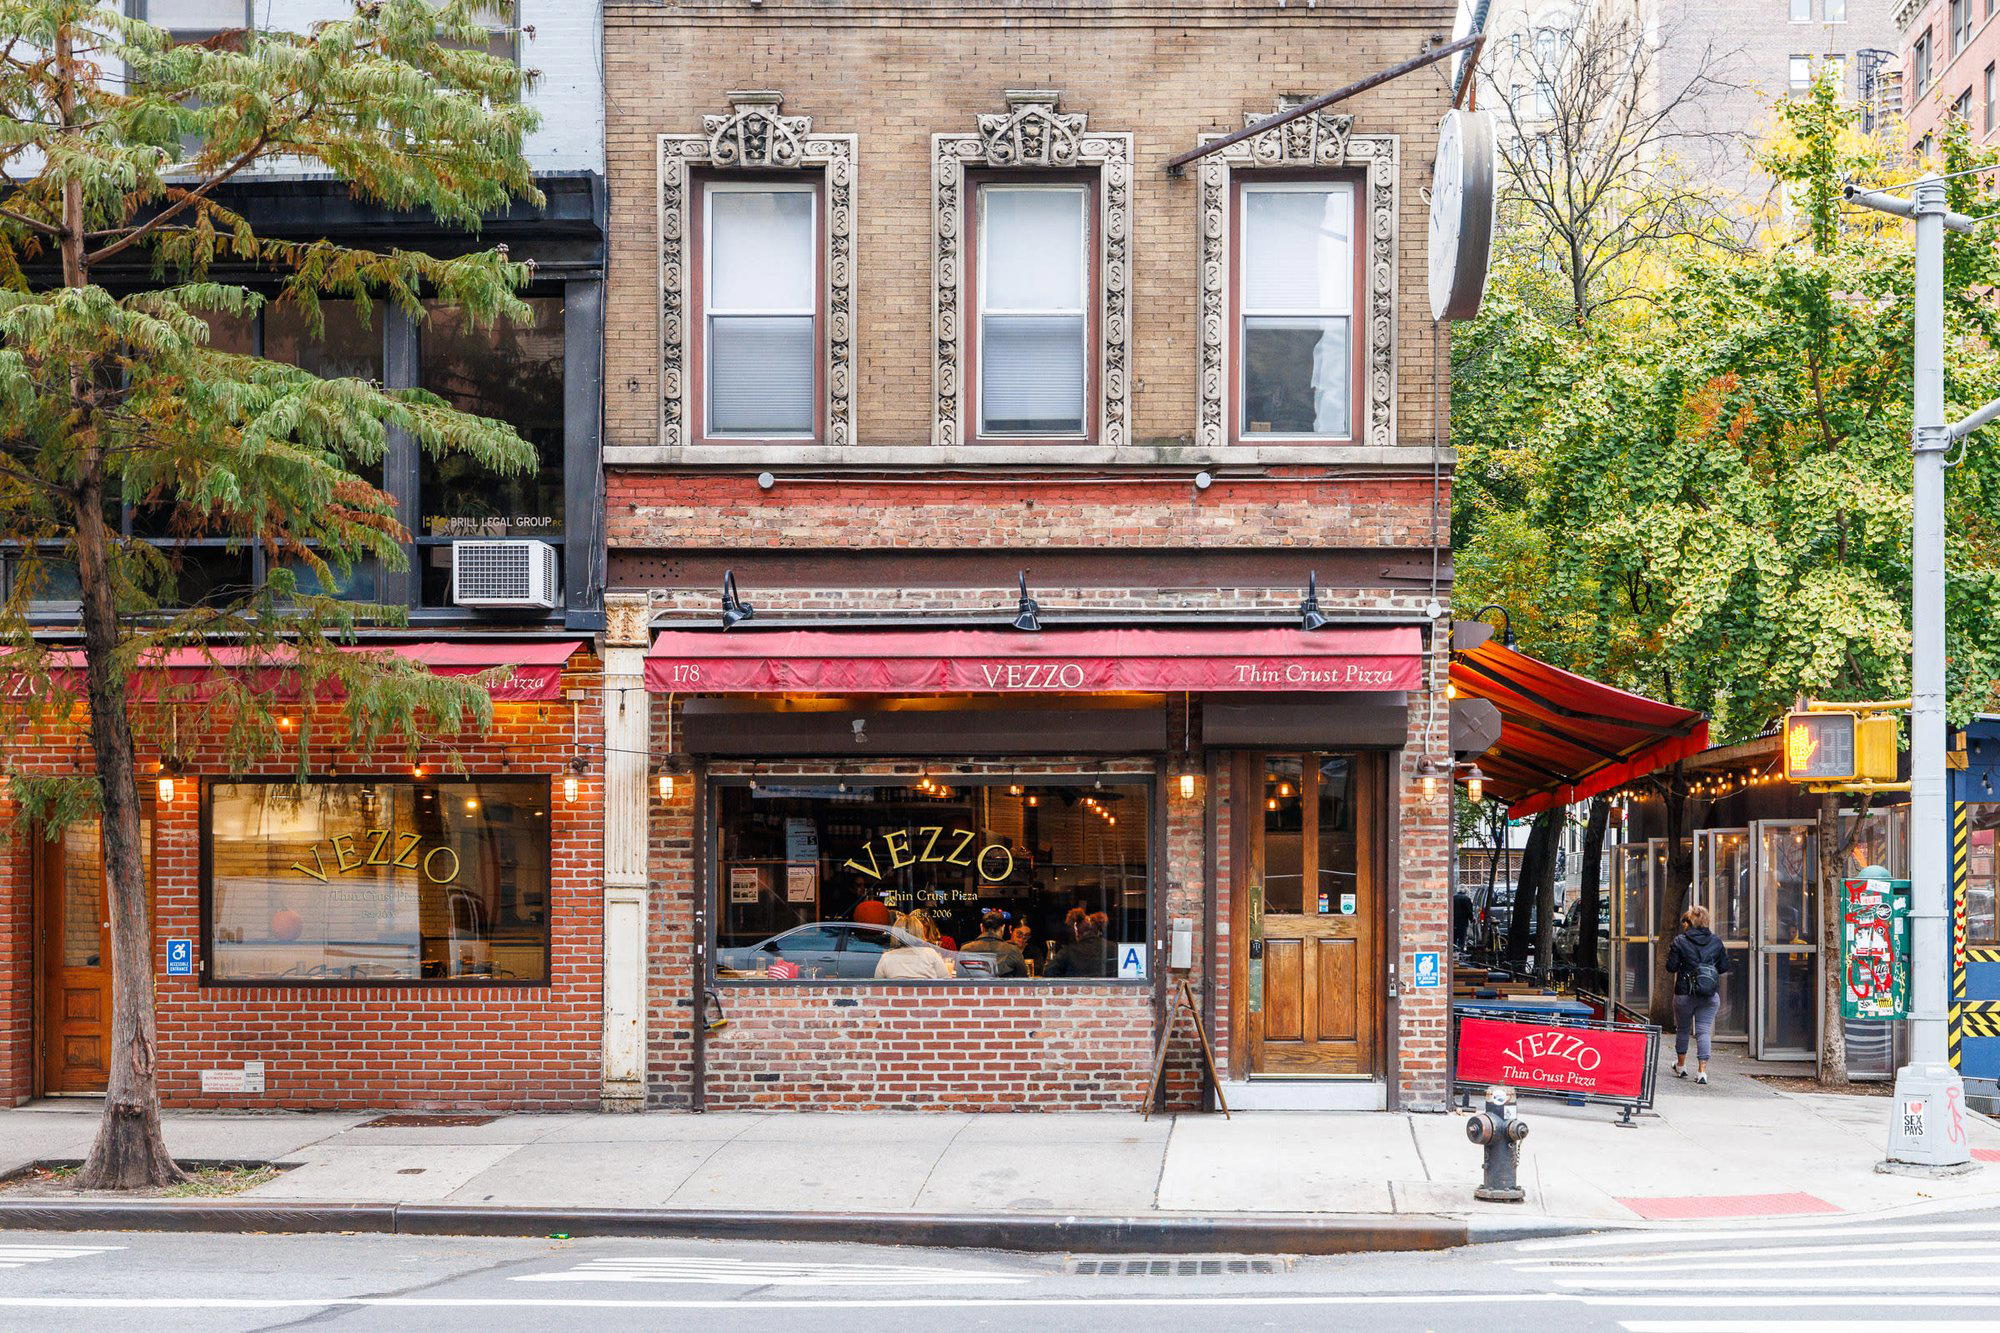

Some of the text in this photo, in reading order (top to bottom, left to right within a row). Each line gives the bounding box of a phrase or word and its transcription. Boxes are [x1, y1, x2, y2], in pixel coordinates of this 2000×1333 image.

[450, 517, 479, 527] BRILL
[481, 517, 512, 527] LEGAL
[516, 517, 551, 527] GROUP
[502, 671, 545, 690] Pizza
[673, 664, 700, 682] 178
[980, 663, 1085, 689] VEZZO
[1234, 664, 1394, 685] Thin Crust Pizza
[291, 829, 460, 885] VEZZO
[843, 826, 1014, 882] VEZZO
[887, 889, 979, 901] Thin Crust Pizza
[932, 909, 952, 919] 2006
[1122, 947, 1140, 969] A
[1502, 1031, 1601, 1071] VEZZO
[1503, 1065, 1596, 1086] Thin Crust Pizza
[1904, 1102, 1907, 1114] I
[1904, 1115, 1922, 1125] SEX
[1904, 1125, 1923, 1135] PAYS
